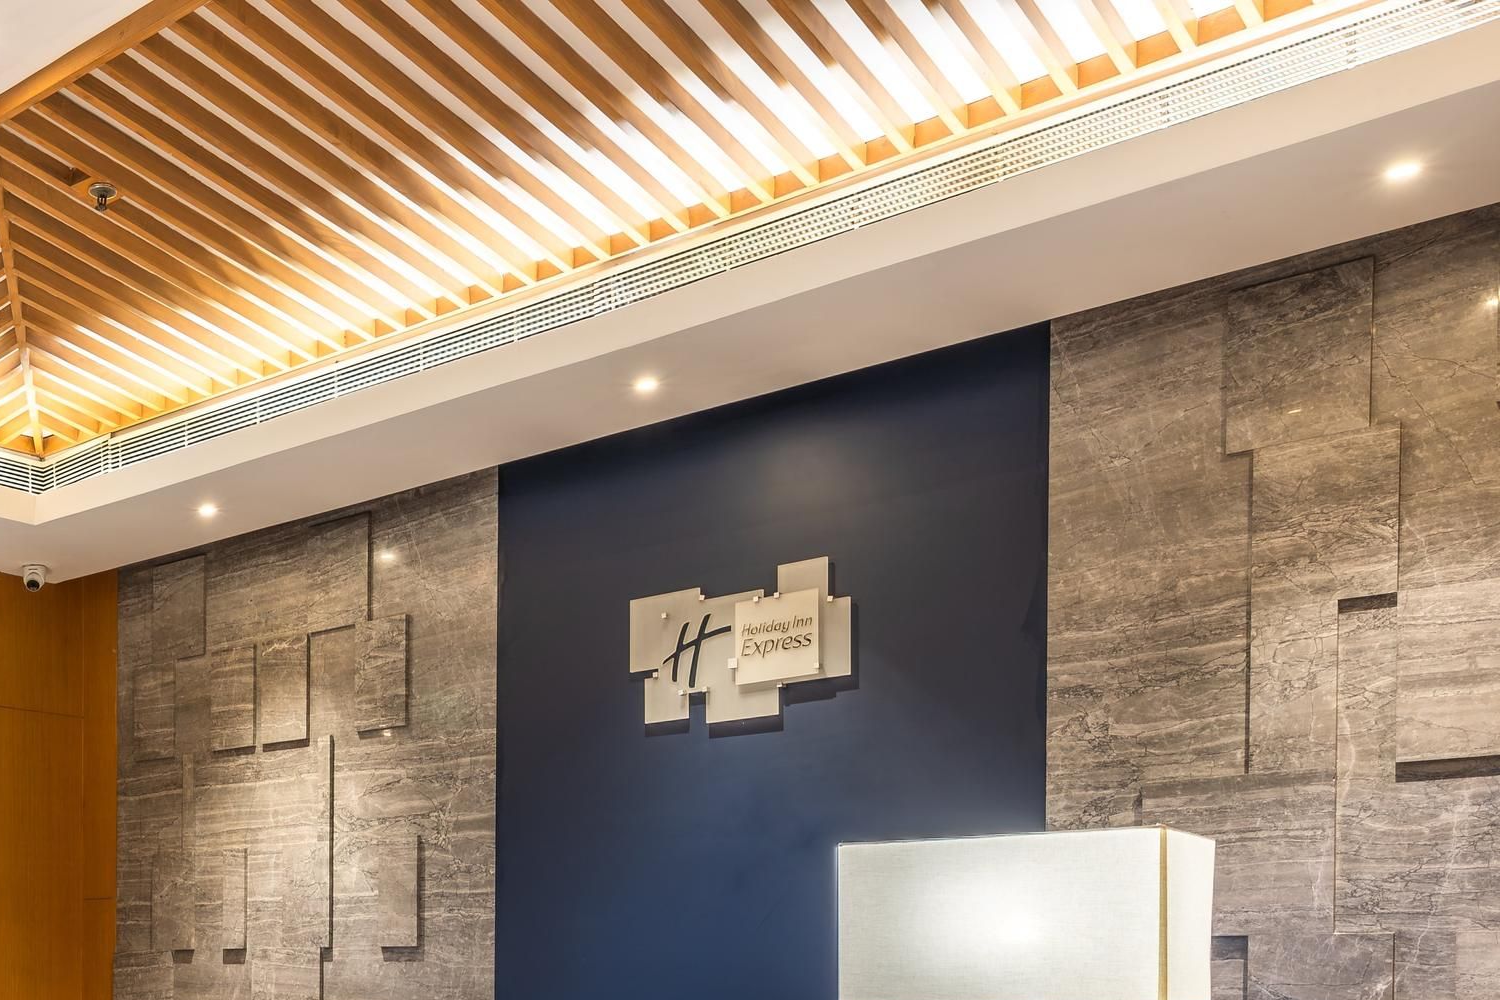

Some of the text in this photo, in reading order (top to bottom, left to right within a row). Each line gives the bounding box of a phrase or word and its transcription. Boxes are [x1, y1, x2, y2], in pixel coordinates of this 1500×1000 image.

[741, 615, 813, 636] Holiday Inn
[741, 632, 813, 658] Express
